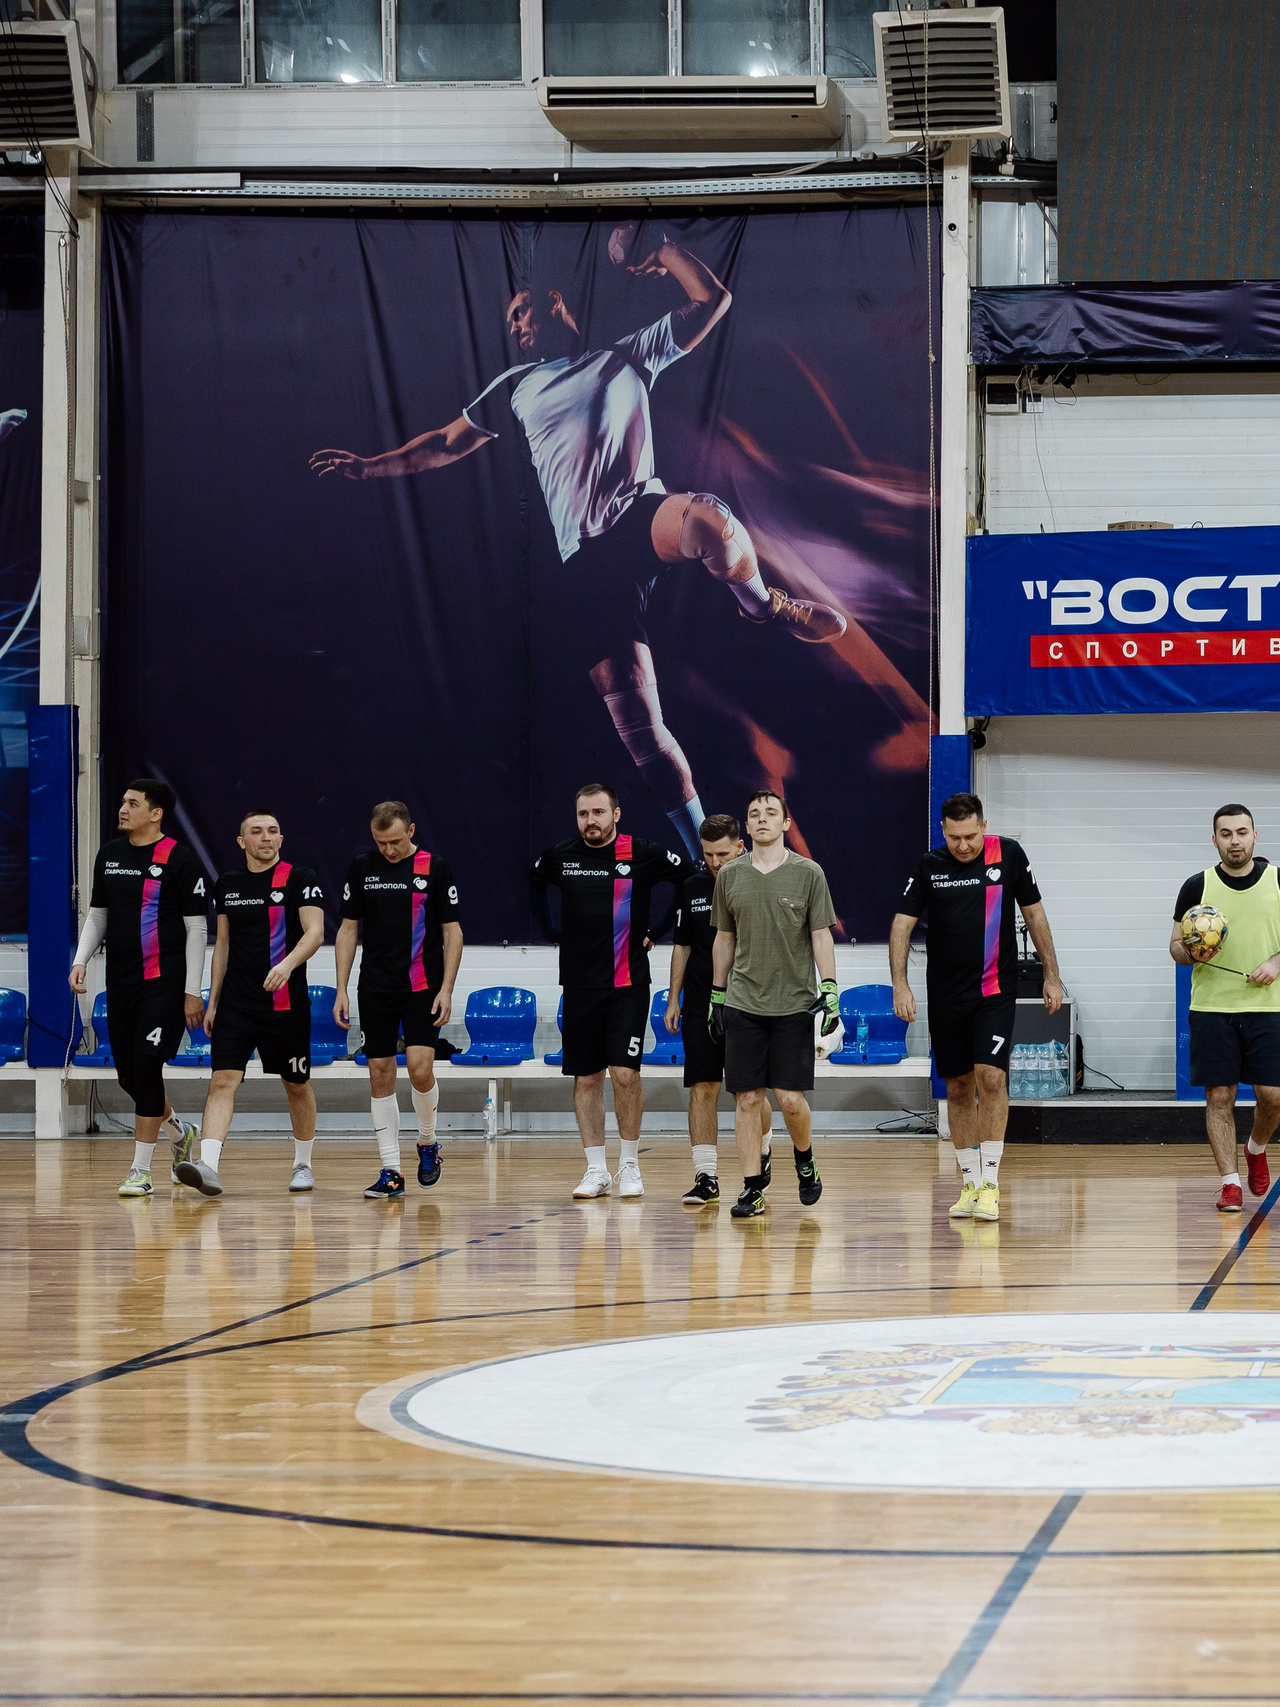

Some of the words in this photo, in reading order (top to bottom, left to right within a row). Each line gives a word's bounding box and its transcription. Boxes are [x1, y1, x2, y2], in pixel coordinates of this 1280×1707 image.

[193, 877, 206, 897] 4
[932, 878, 981, 889] СТАВРОПОЛЬ
[447, 885, 459, 905] 9
[146, 1026, 162, 1046] 4
[991, 1035, 1005, 1055] 7
[627, 1036, 641, 1057] 5
